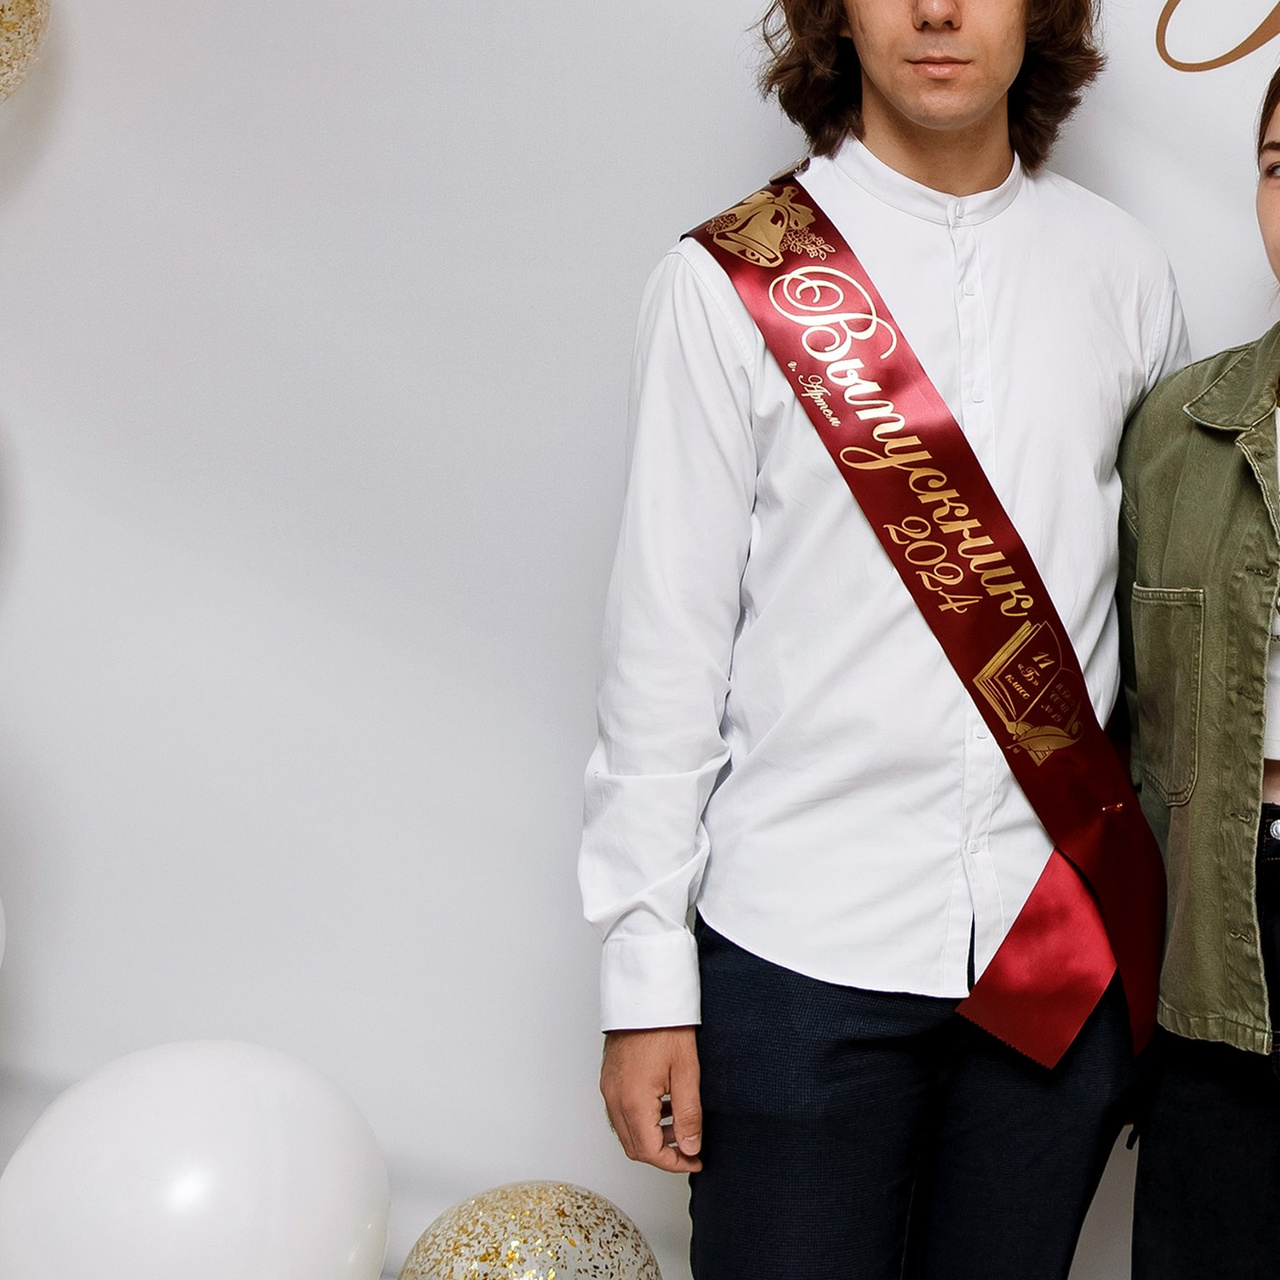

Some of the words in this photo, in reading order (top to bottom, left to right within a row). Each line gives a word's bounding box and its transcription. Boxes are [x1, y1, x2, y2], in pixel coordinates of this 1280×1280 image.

[768, 265, 1034, 617] Выпускник
[883, 516, 983, 613] 2024
[1032, 651, 1055, 669] 11
